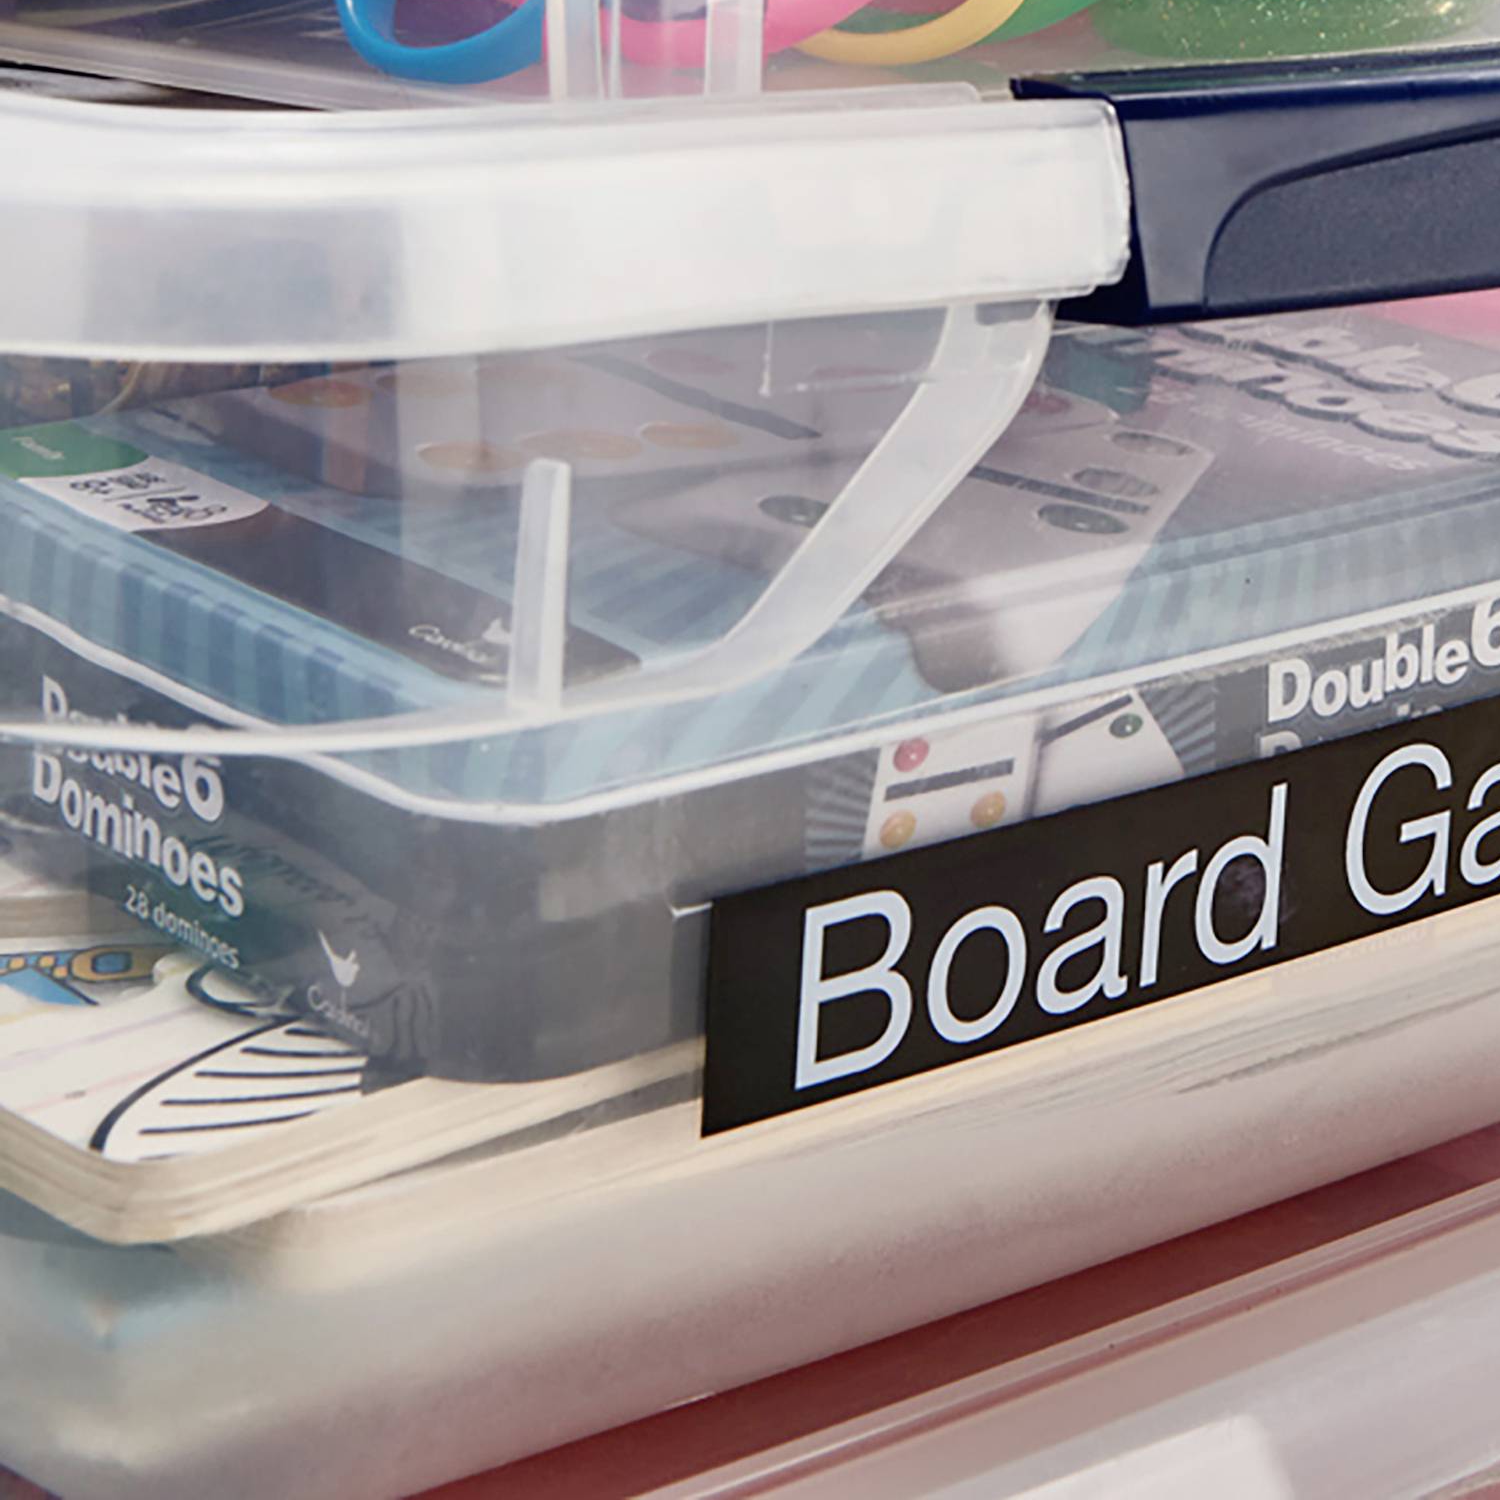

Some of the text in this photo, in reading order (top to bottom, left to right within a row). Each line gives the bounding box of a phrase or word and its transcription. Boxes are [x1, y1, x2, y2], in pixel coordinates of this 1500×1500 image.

[33, 752, 245, 918] Dominoes
[124, 883, 240, 971] 28 dominoes
[792, 783, 1288, 1092] Board
